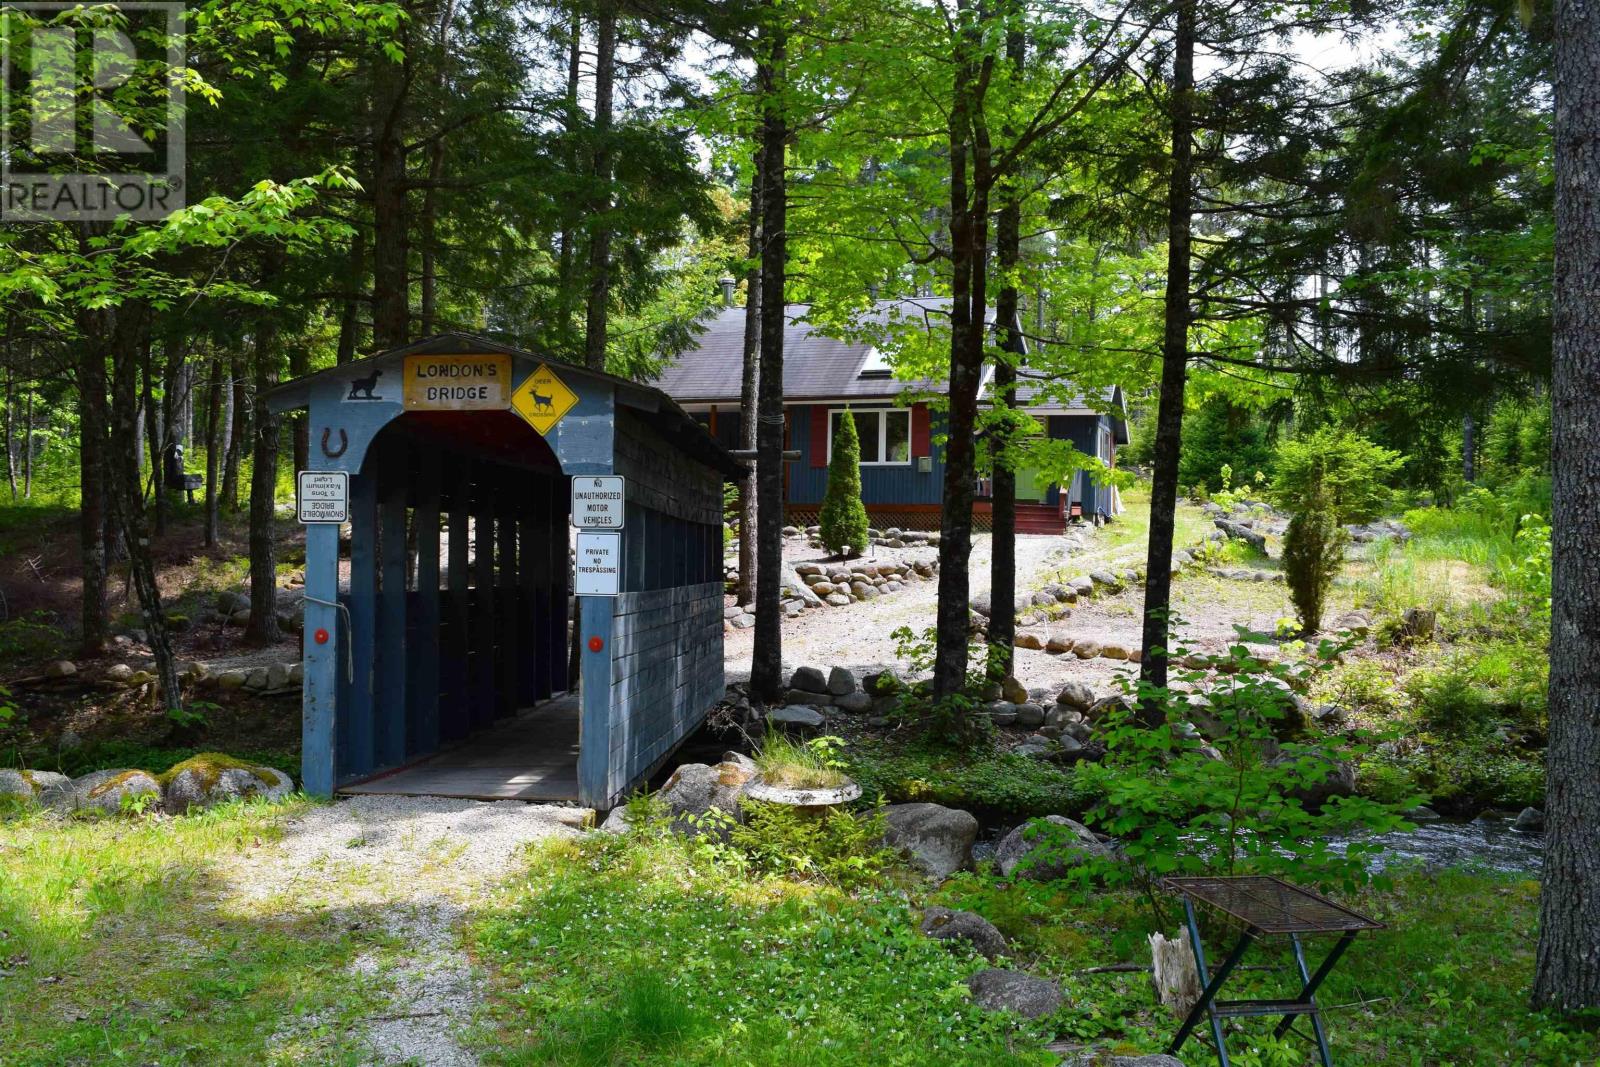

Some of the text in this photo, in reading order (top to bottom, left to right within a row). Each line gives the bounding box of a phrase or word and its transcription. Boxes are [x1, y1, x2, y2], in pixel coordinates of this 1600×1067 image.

[417, 364, 497, 378] LONDON'S
[427, 386, 488, 400] BRIDGE
[593, 479, 602, 487] NO
[575, 491, 621, 500] UNAUTHORIZED
[587, 504, 608, 512] MOTOR
[302, 510, 344, 518] SNOWMOBILE
[583, 516, 612, 524] VEHICLES
